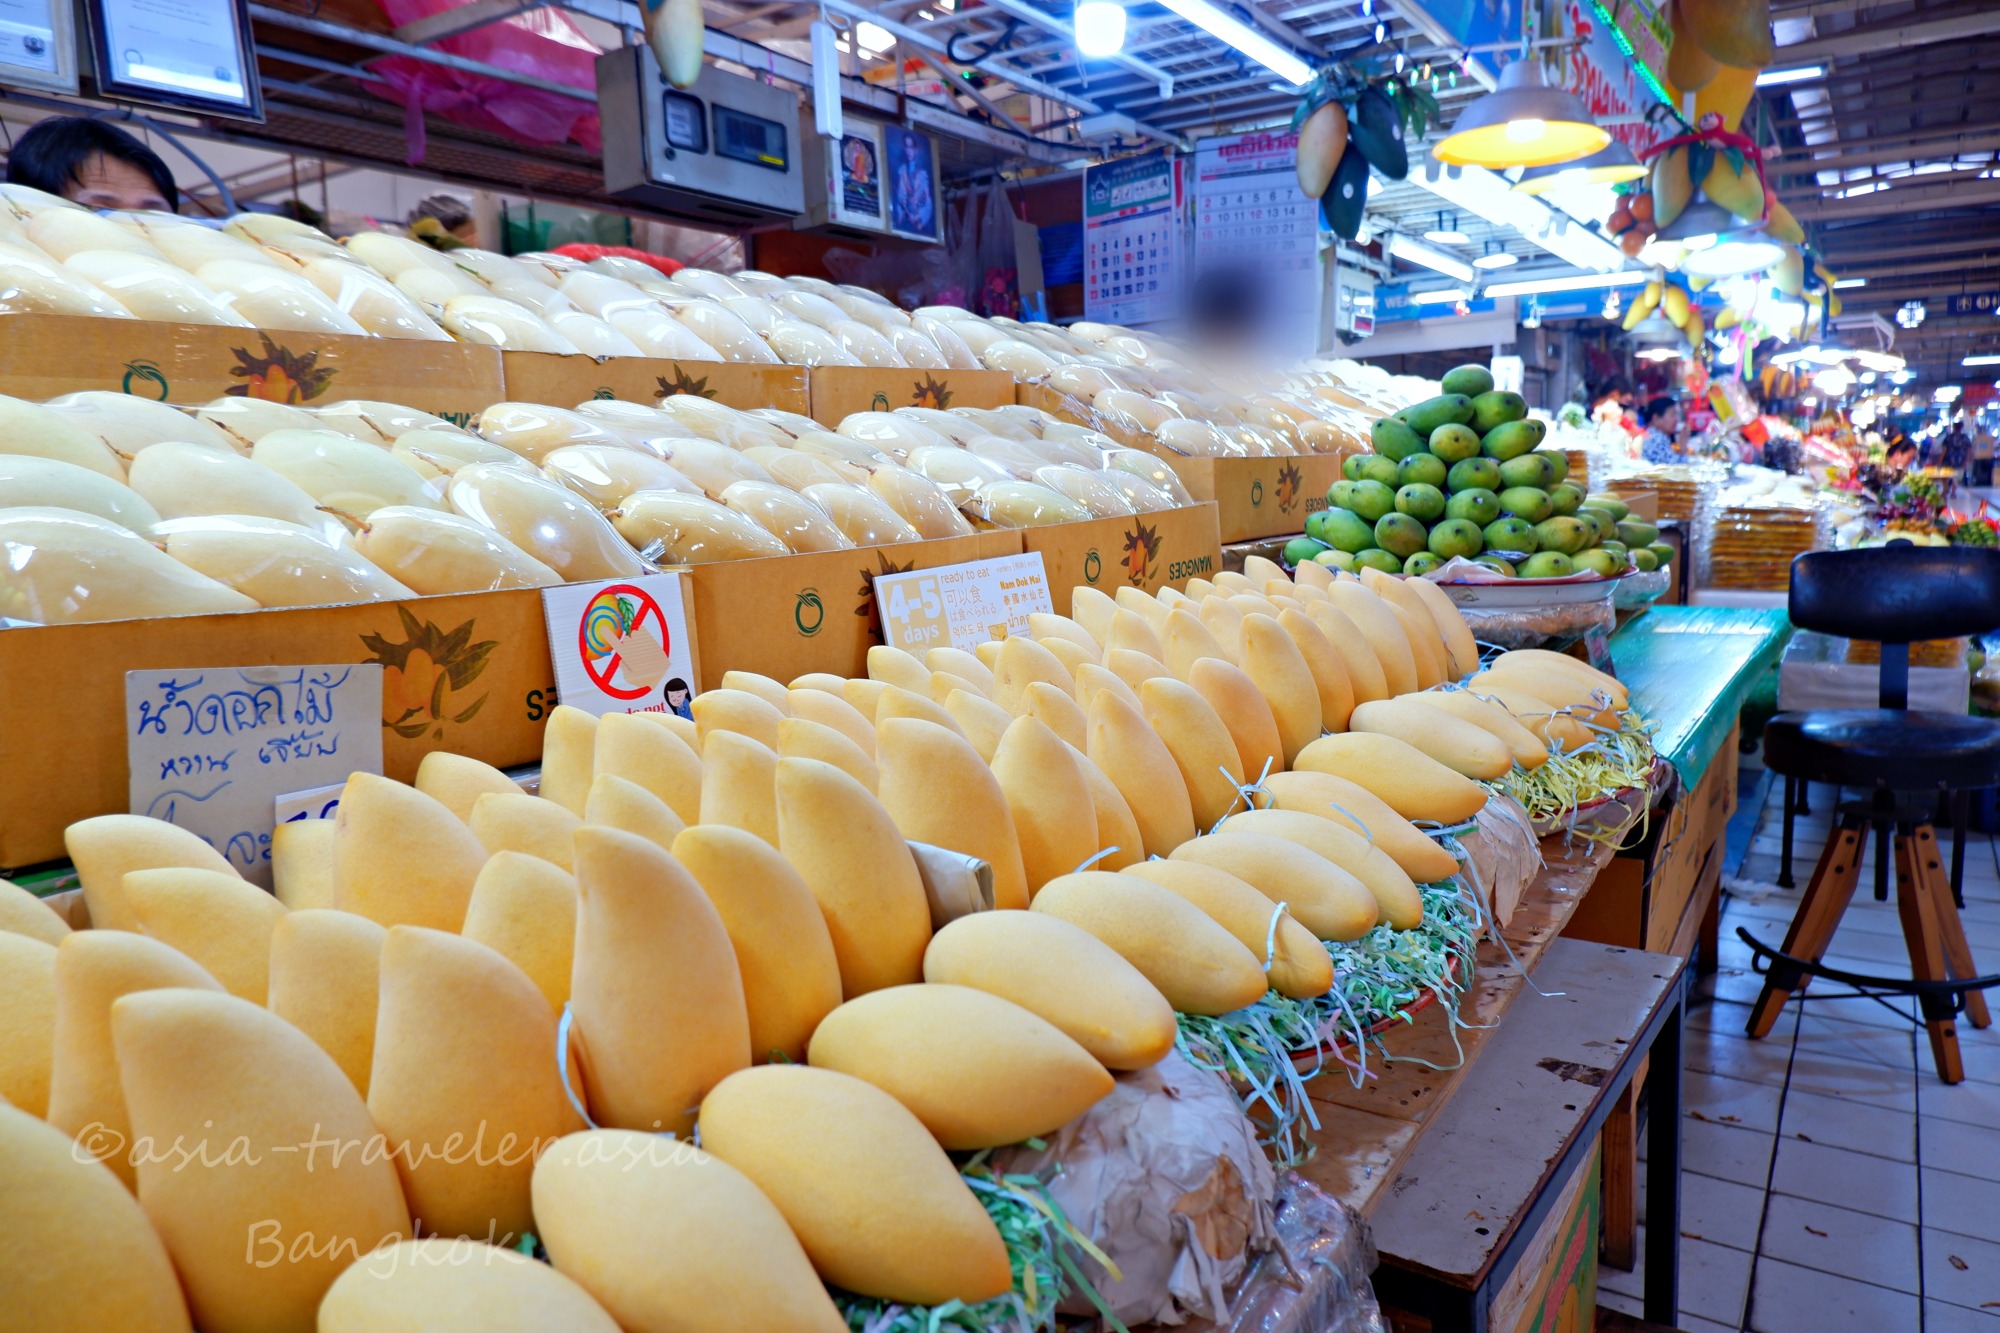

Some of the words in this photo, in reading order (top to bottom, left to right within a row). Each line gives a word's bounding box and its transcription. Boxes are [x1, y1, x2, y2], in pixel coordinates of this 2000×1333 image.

[1204, 198, 1212, 209] 2
[1220, 196, 1227, 207] 3
[1236, 195, 1243, 204] 4
[1253, 193, 1260, 203] 5
[1269, 191, 1276, 202] 6
[1287, 189, 1293, 200] 7
[1204, 214, 1211, 224] 9
[1218, 212, 1230, 222] 10
[1234, 211, 1245, 220] 11
[1250, 209, 1262, 219] 12
[1267, 208, 1279, 218] 13
[1284, 206, 1295, 216] 14
[1218, 229, 1228, 238] 17
[1250, 226, 1261, 235] 19
[1266, 225, 1278, 234] 20
[1282, 223, 1294, 233] 21
[940, 570, 964, 585] ready
[966, 568, 975, 580] to
[976, 567, 991, 579] eat
[1169, 554, 1213, 581] MANGOES
[1000, 579, 1016, 591] Nam
[1016, 576, 1029, 588] Dok
[1029, 574, 1042, 586] Mai
[889, 579, 941, 624] 4-5
[943, 584, 983, 608] 可以食
[950, 603, 997, 623] は食べられる
[904, 623, 940, 645] days
